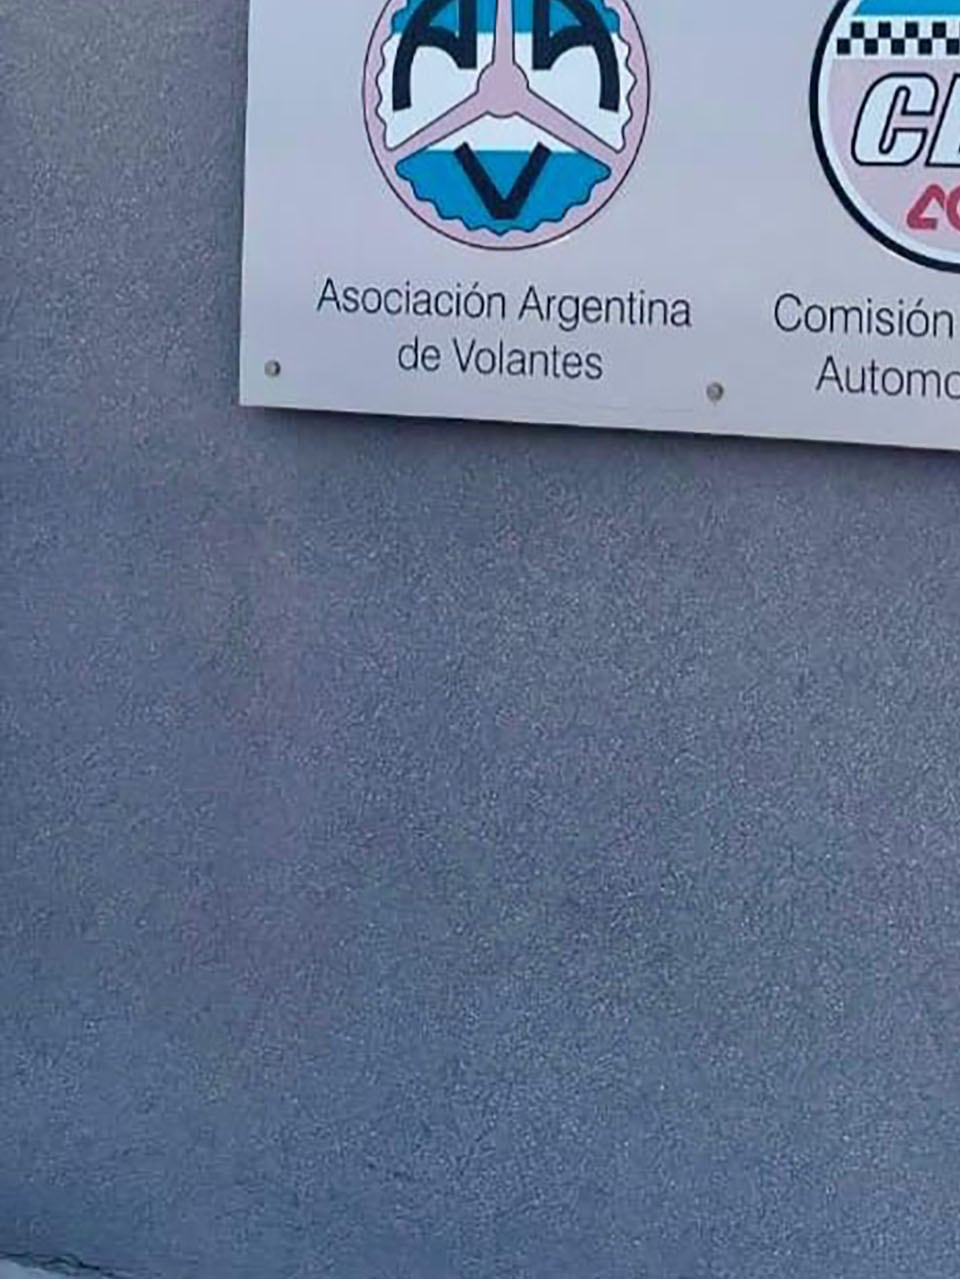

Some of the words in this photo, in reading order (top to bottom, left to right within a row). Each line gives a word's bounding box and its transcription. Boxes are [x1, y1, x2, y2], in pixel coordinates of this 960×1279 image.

[315, 276, 507, 320] Asociación
[517, 284, 693, 332] Argentina
[773, 292, 955, 341] Comisión
[397, 335, 442, 373] de
[453, 335, 604, 381] Volantes
